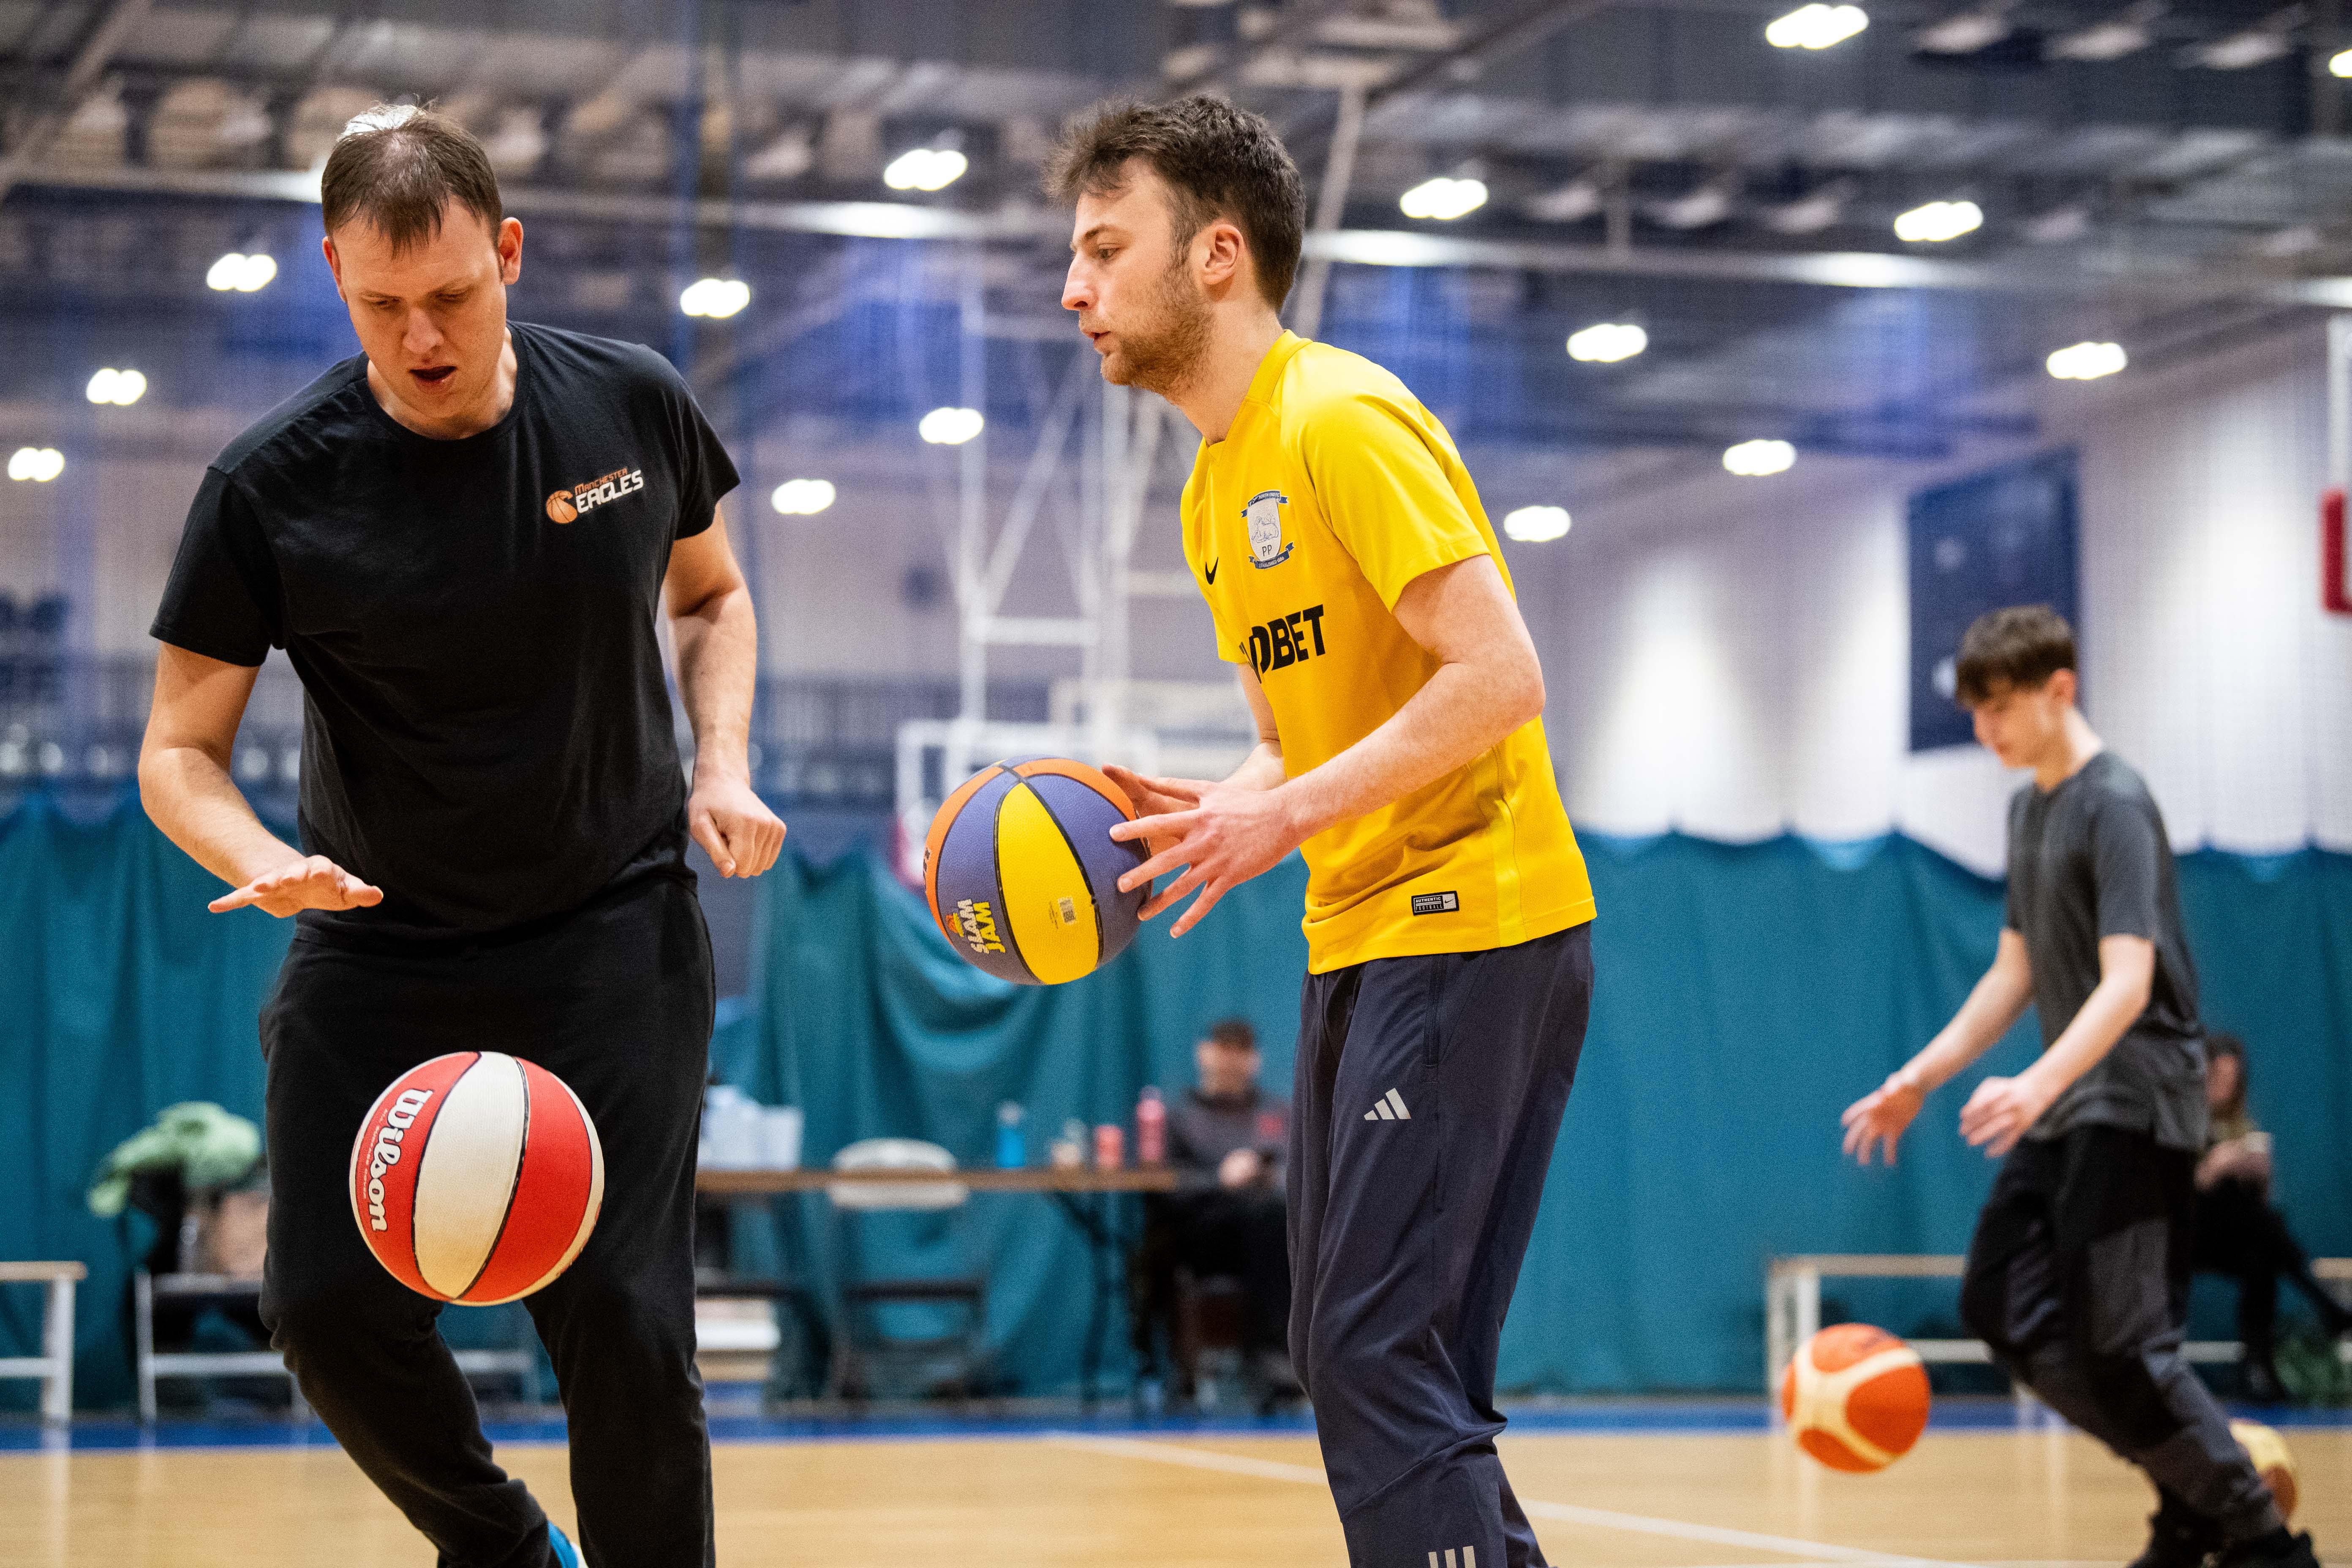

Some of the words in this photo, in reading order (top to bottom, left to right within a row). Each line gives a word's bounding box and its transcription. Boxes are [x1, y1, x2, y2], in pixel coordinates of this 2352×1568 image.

[576, 470, 644, 514] EAGLES
[958, 899, 989, 954] SLAM
[973, 901, 1006, 953] JAM
[369, 1088, 435, 1231] Wilson
